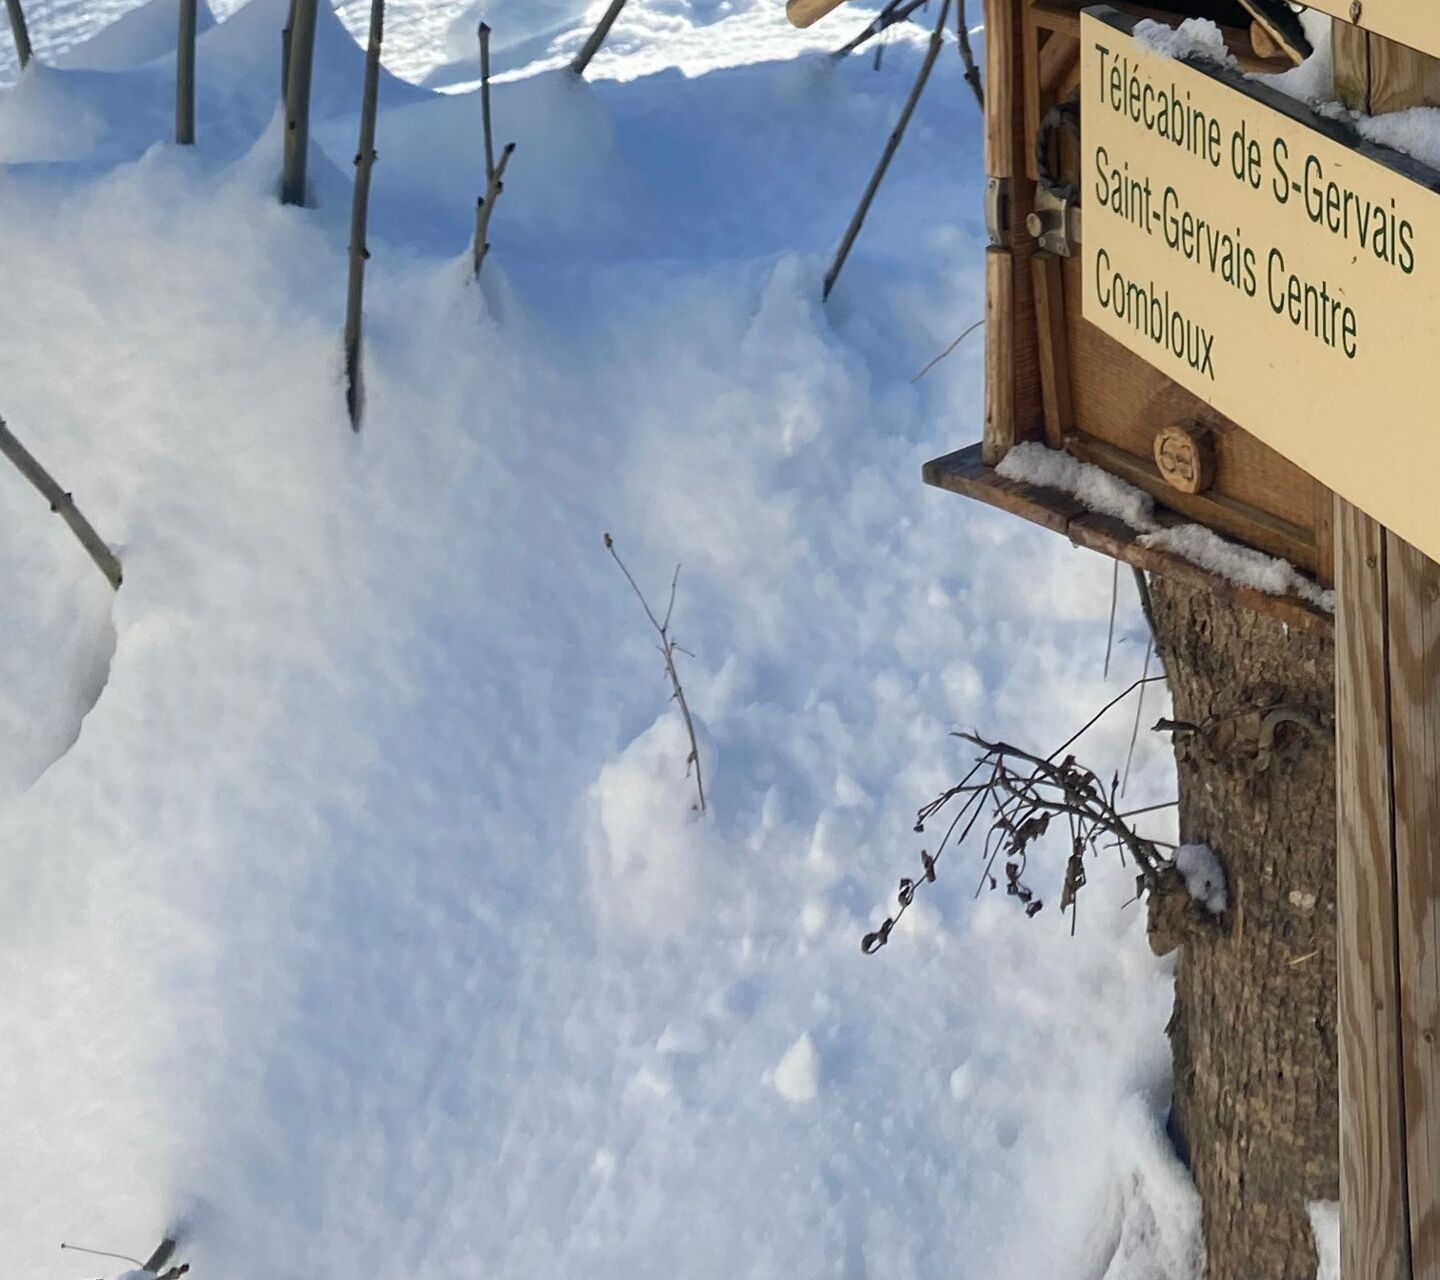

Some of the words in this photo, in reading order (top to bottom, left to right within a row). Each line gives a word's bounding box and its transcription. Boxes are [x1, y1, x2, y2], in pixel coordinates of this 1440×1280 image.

[1096, 44, 1221, 168] Télécabine
[1232, 120, 1261, 189] de
[1273, 138, 1414, 274] S-Gervais
[1096, 146, 1256, 297] Saint-Gervais
[1268, 248, 1356, 359] Centre
[1096, 248, 1214, 381] Combloux
